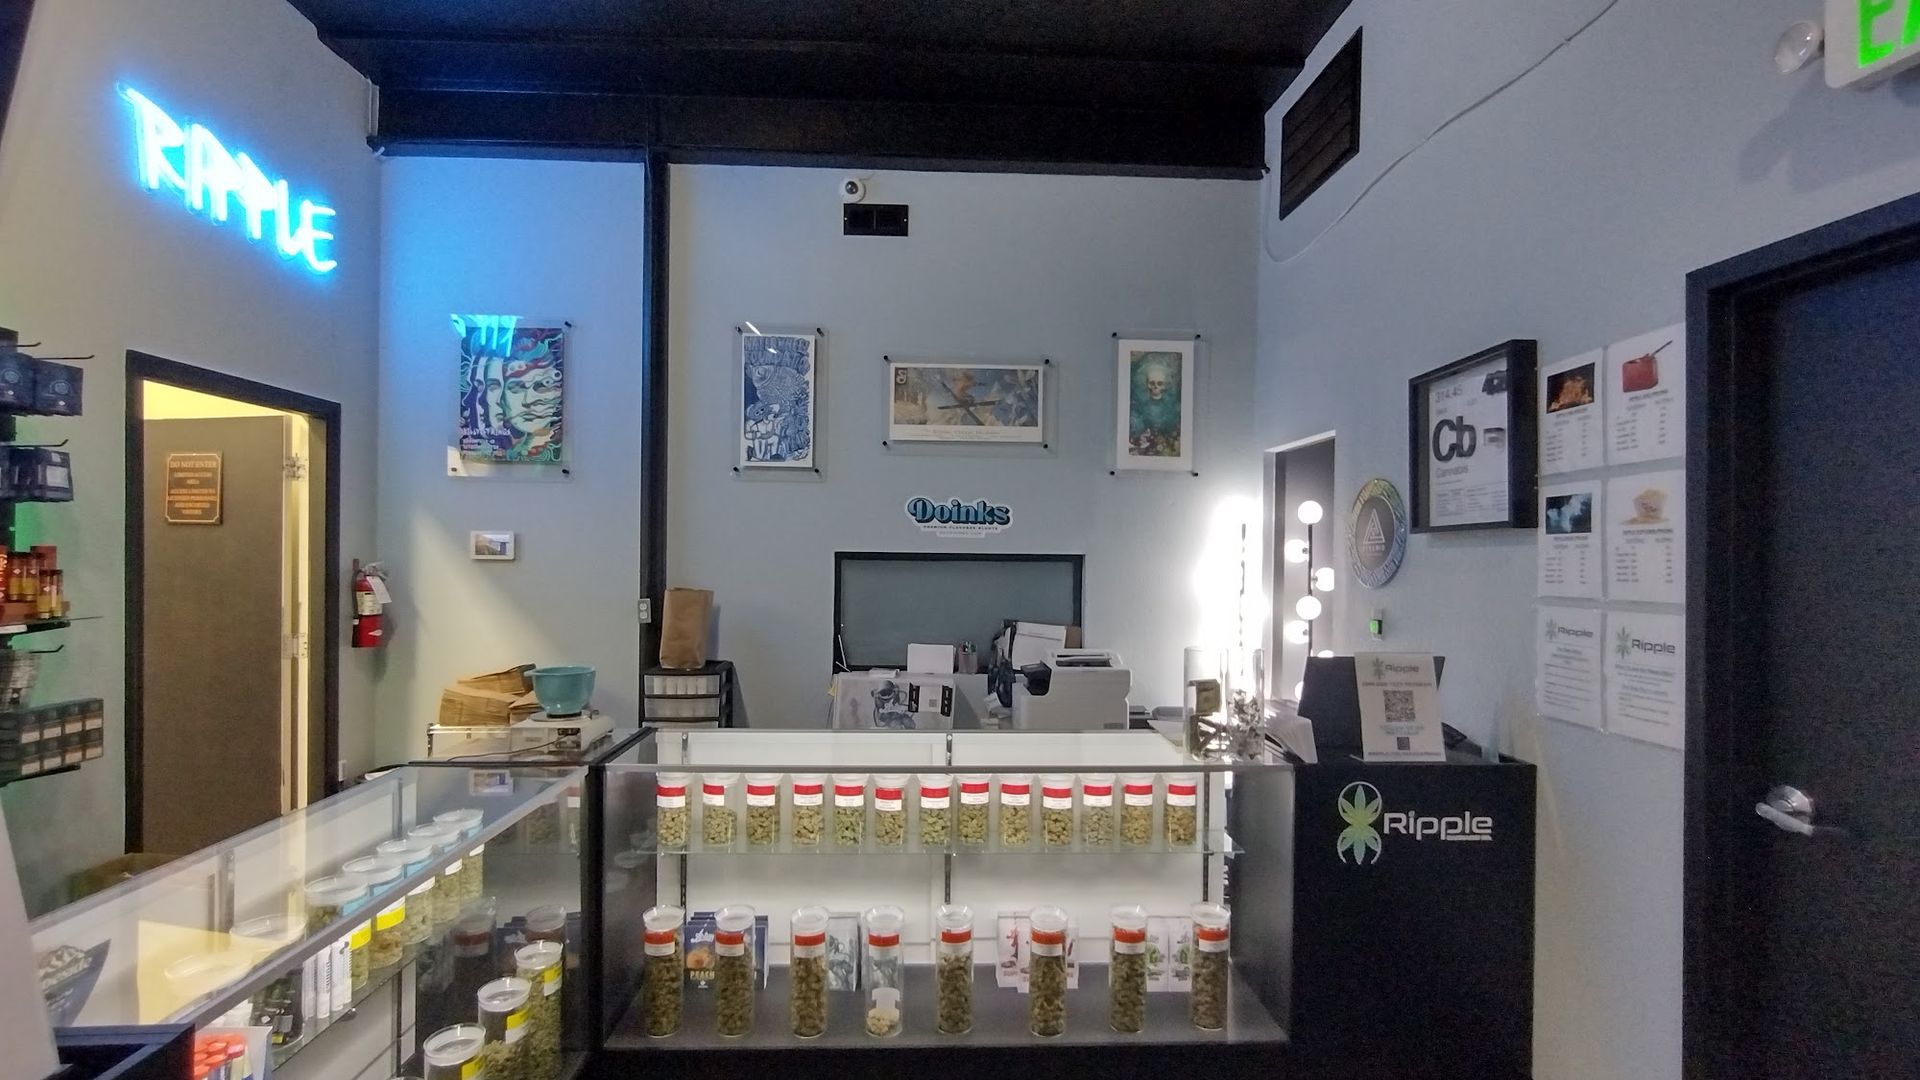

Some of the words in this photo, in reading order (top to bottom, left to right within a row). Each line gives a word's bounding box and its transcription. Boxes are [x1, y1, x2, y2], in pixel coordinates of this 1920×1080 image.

[1432, 415, 1477, 462] Cb
[907, 498, 1011, 526] Doinks
[1557, 626, 1594, 638] Ripple
[1631, 639, 1676, 654] Ripple
[1384, 664, 1420, 674] Ripple
[1383, 810, 1493, 841] Ripple
